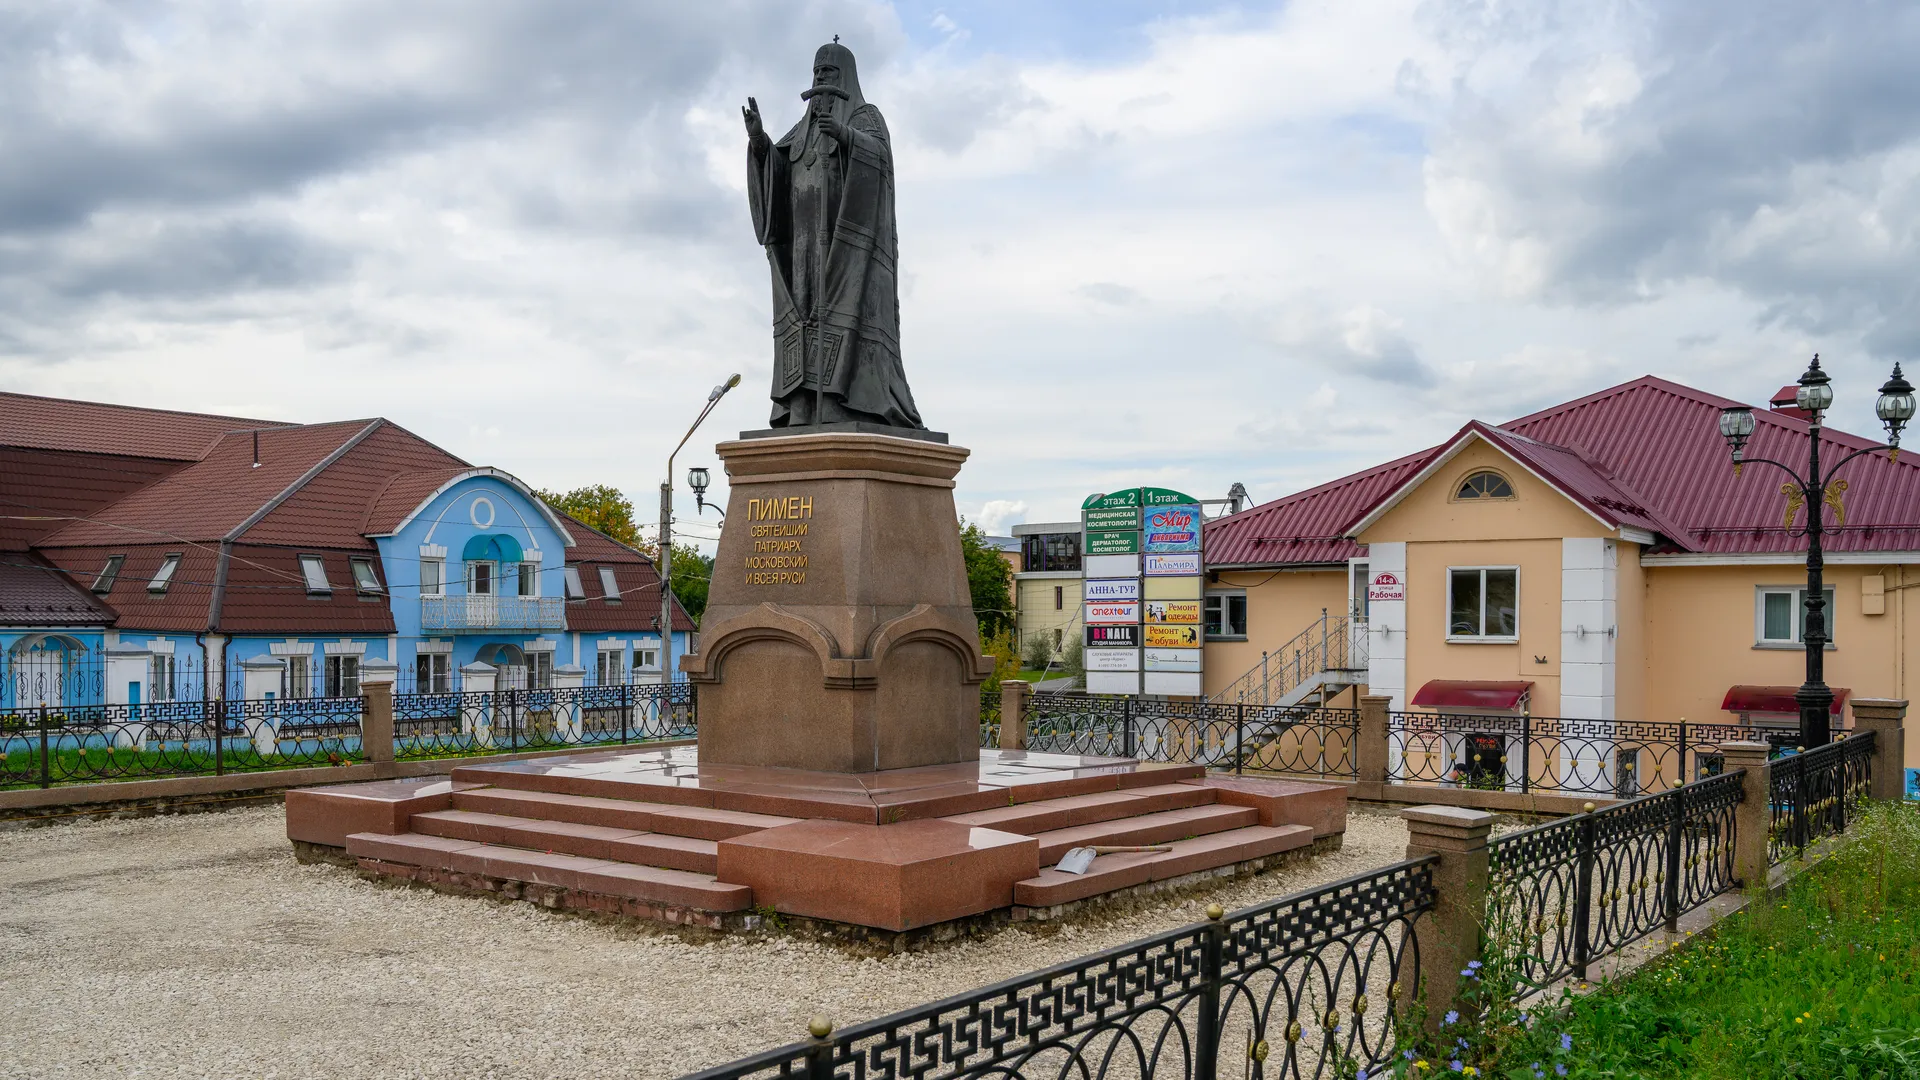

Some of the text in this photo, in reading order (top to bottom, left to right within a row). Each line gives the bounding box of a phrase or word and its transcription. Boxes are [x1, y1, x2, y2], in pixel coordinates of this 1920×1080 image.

[1103, 492, 1136, 506] этаж 2
[1147, 491, 1179, 503] 1 этаж
[747, 496, 814, 521] ПИМЕН
[1088, 511, 1136, 519] МЕДИЦИНСКАЯ
[1152, 510, 1192, 531] Мир
[754, 540, 802, 553] ПАТРИАРХ
[745, 554, 808, 569] МОСКОВСКИЙ
[745, 572, 806, 585] И ВСЕЯ РУСИ
[1088, 585, 1136, 595] АННА-ТУР
[1168, 603, 1197, 611] Ремонт
[1149, 626, 1179, 634] Ремонт
[1155, 637, 1179, 646] обуви
